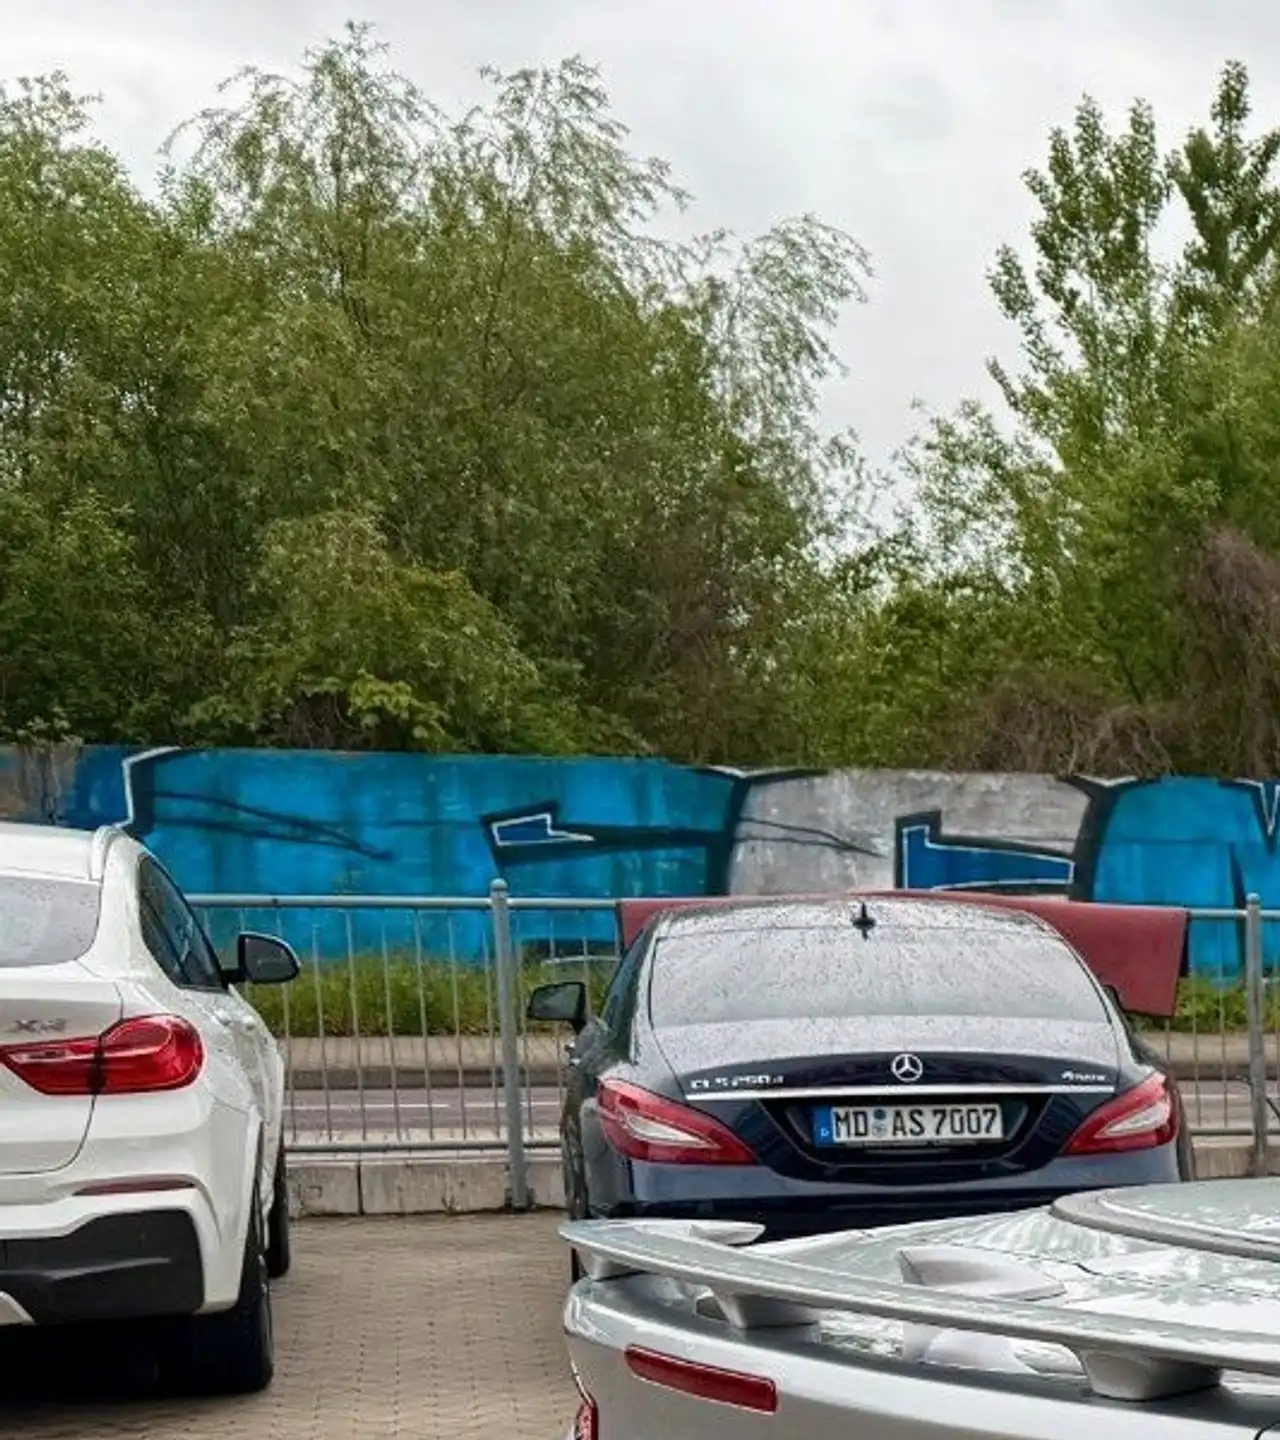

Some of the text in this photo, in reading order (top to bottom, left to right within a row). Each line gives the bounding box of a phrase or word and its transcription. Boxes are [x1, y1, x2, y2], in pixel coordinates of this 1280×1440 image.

[834, 1107, 998, 1138] MD AS 7007
